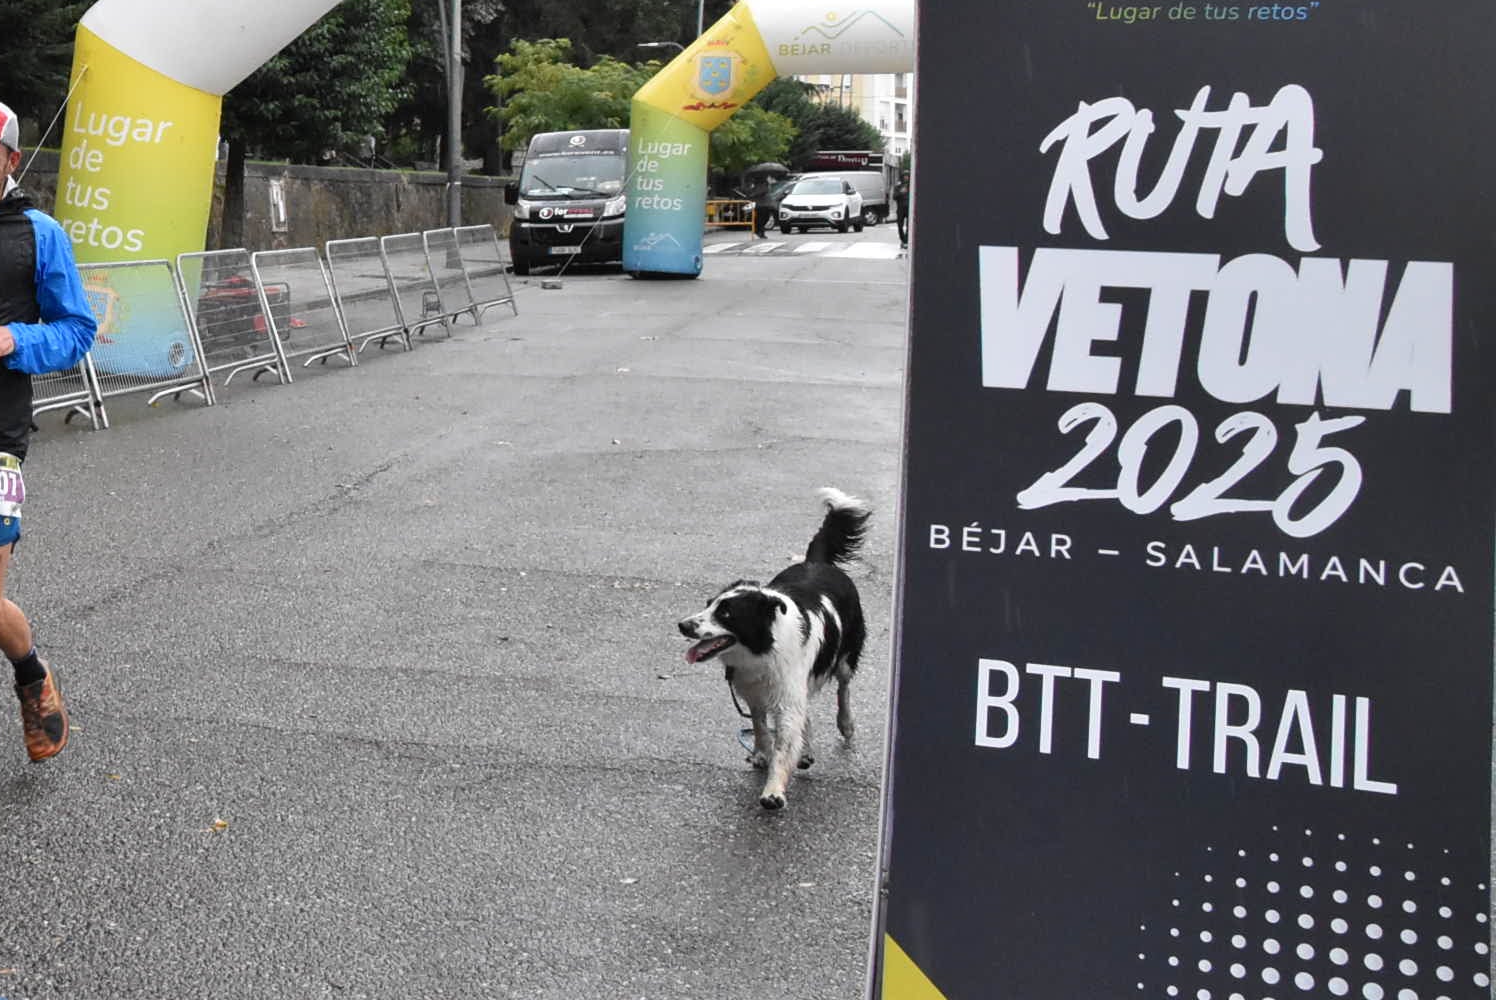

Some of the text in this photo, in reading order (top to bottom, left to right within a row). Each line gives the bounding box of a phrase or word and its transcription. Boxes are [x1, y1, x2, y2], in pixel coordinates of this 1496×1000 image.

[1168, 1, 1197, 21] de
[1204, 2, 1240, 21] tus
[73, 101, 172, 146] Lugar
[70, 140, 103, 172] de
[637, 154, 658, 172] de
[638, 137, 692, 158] Lugar
[636, 175, 664, 191] tus
[1039, 84, 1323, 252] RUTA
[66, 176, 111, 211] tus
[635, 194, 683, 211] retos
[63, 217, 145, 252] retos
[979, 245, 1454, 414] VETONA
[1016, 402, 1366, 537] 2025
[929, 522, 1072, 559] BÉJAR
[1147, 540, 1464, 593] SALAMANCA
